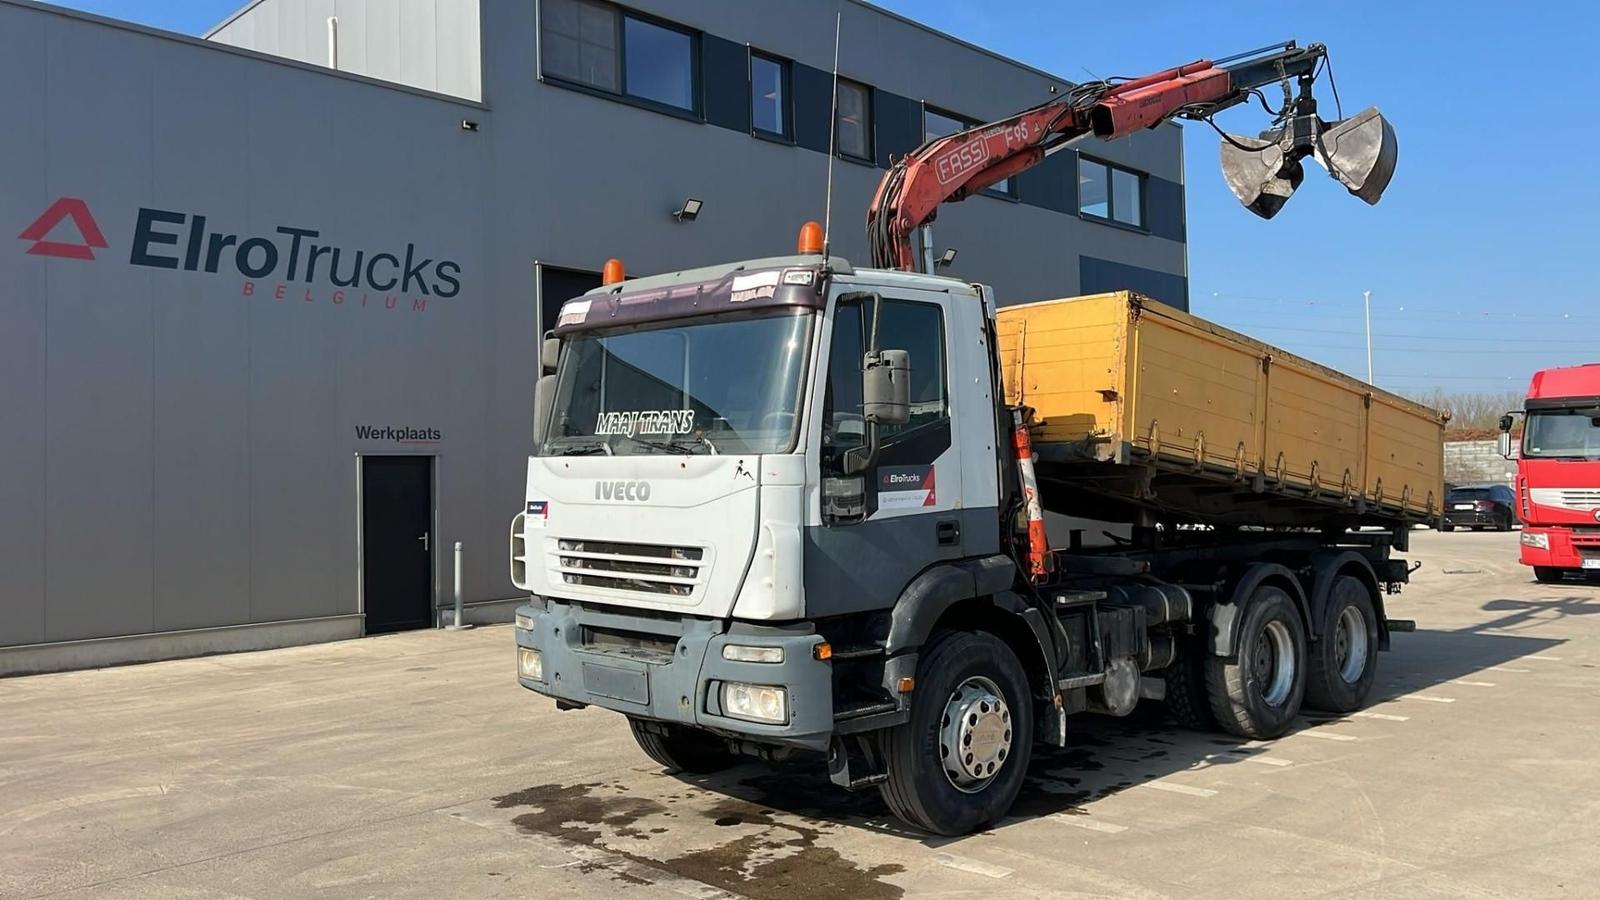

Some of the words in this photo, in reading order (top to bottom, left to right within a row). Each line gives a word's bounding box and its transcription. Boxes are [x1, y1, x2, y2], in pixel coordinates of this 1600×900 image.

[939, 139, 986, 180] FASSI
[130, 207, 461, 298] ElroTrucks
[242, 281, 428, 312] BELGIUM
[355, 425, 441, 442] Werkplaats
[595, 412, 637, 438] MAAJ
[639, 410, 695, 434] TRANS
[595, 482, 651, 502] IVECO
[890, 473, 920, 483] ElroTrucks
